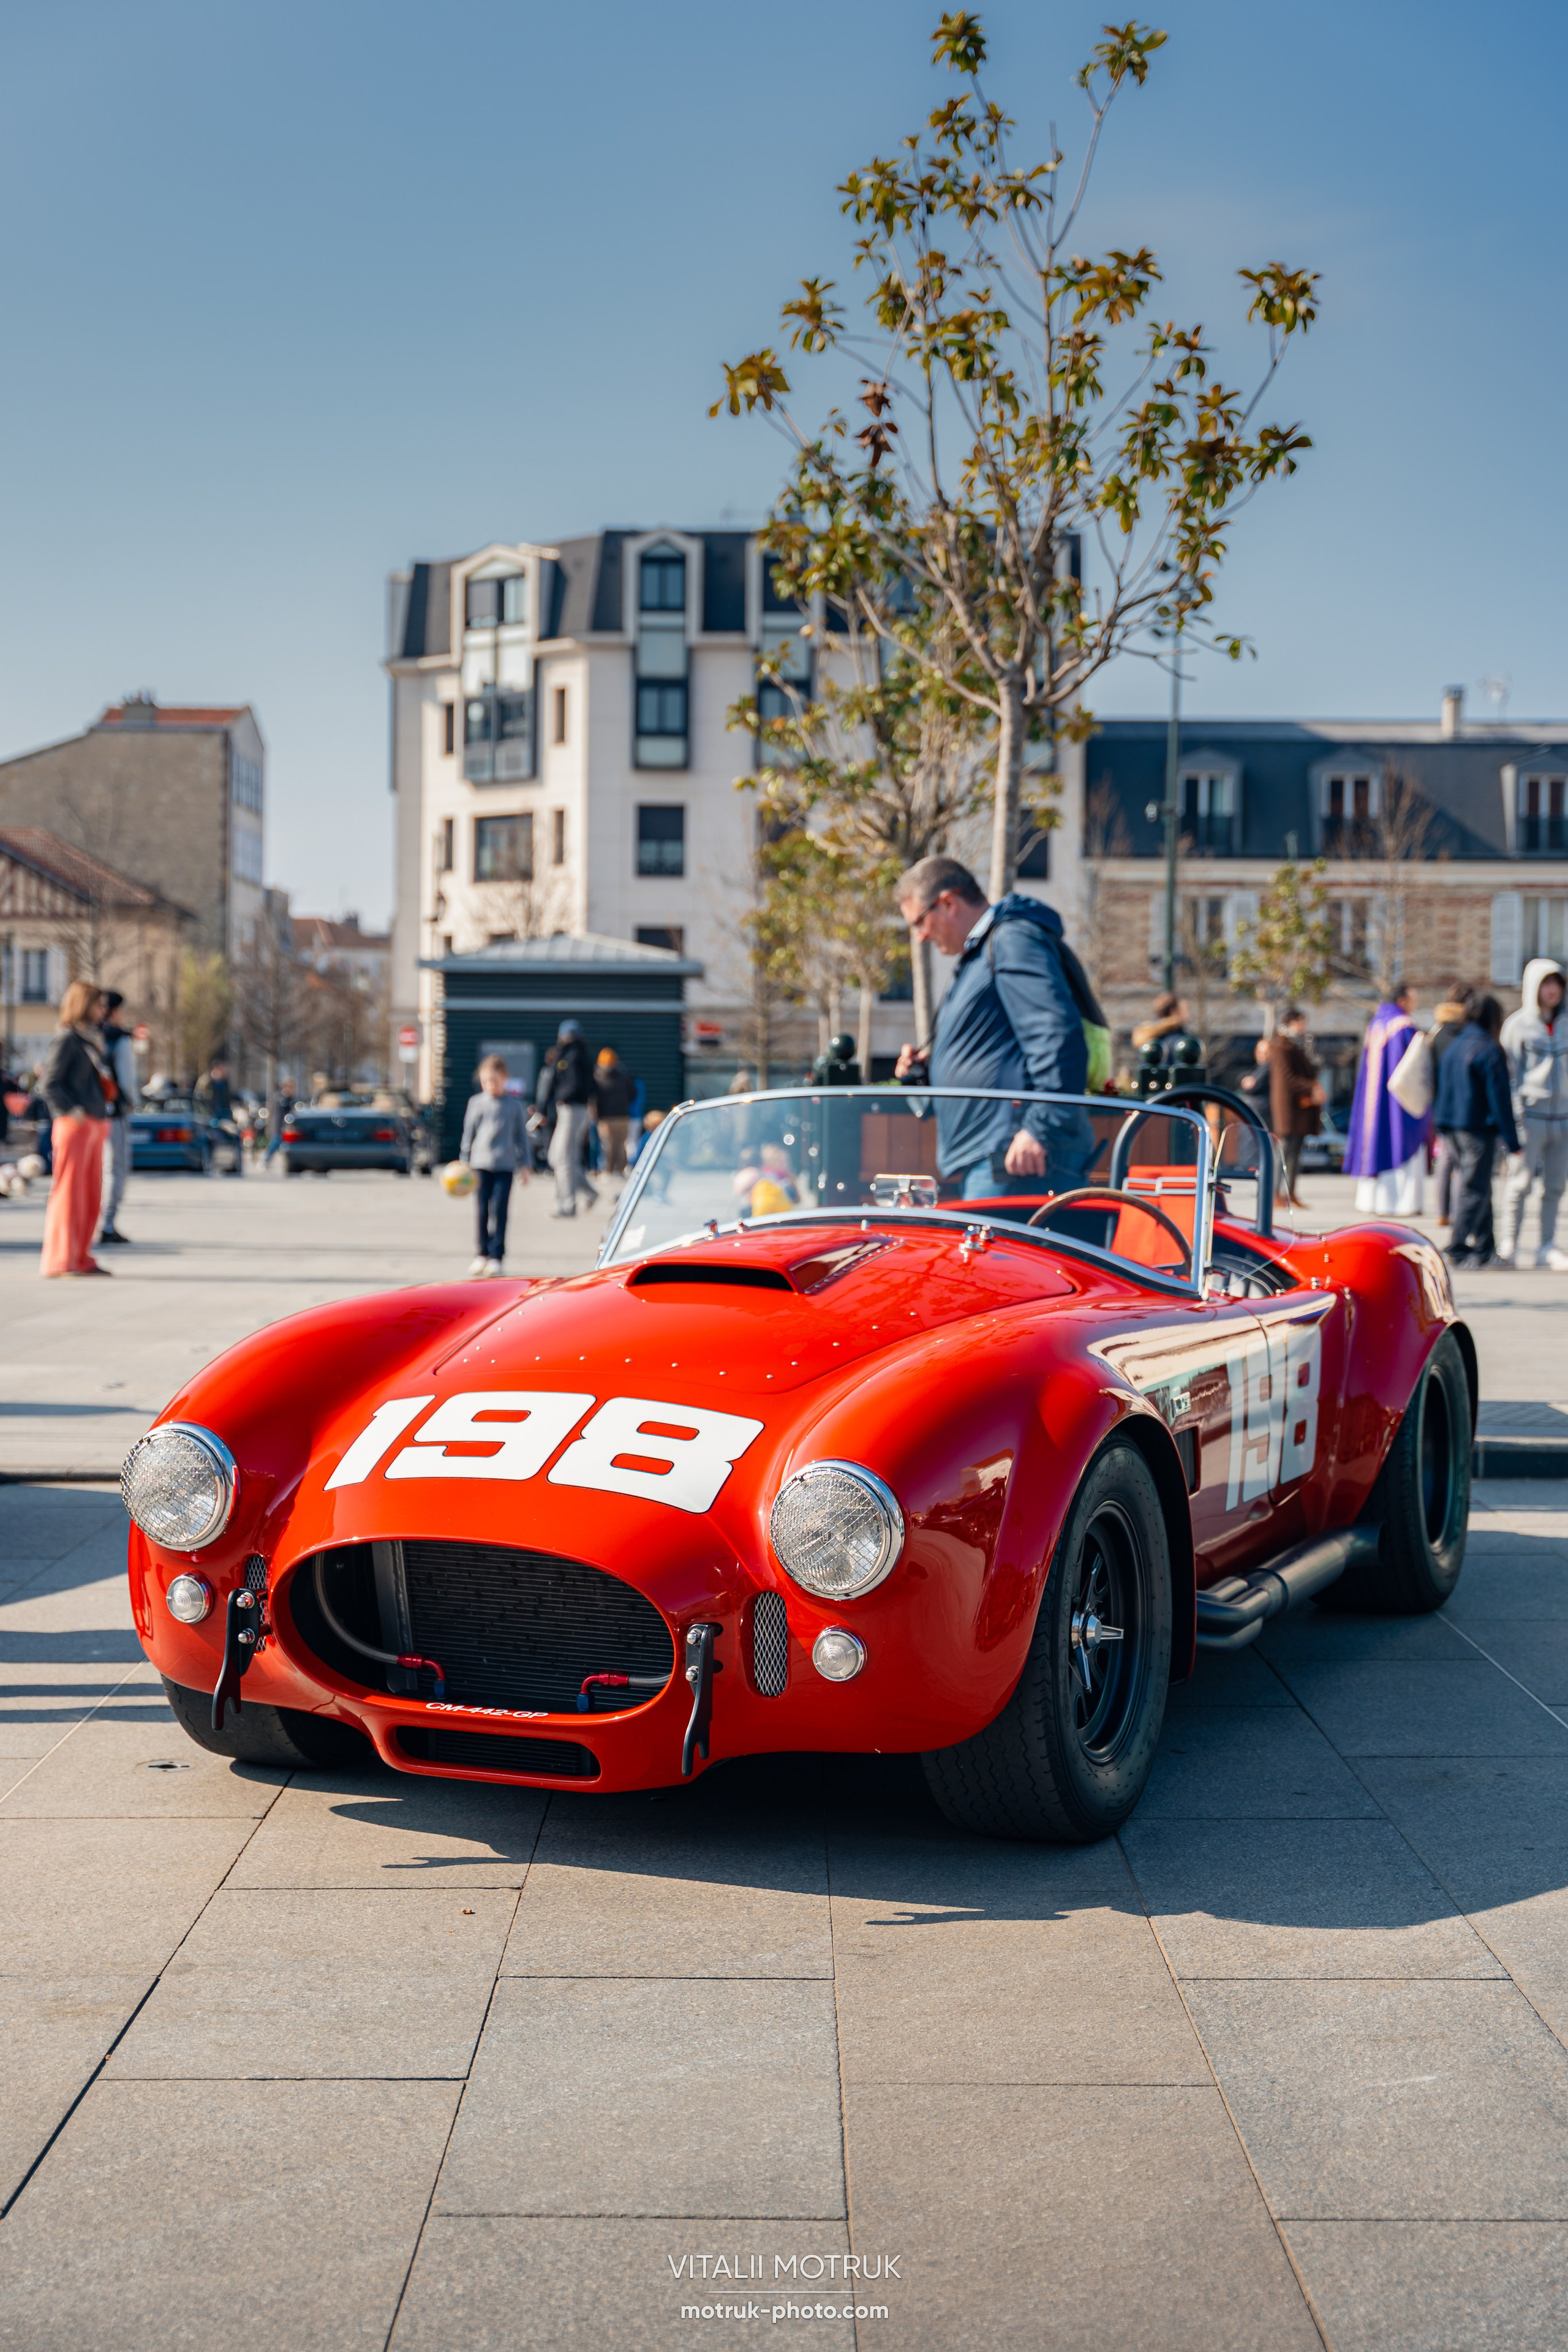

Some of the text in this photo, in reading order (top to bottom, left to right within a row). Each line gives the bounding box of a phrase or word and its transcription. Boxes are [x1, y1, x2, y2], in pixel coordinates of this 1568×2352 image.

[323, 1391, 764, 1514] 198
[1225, 1324, 1322, 1512] 198
[425, 1702, 549, 1718] CM-442-GP
